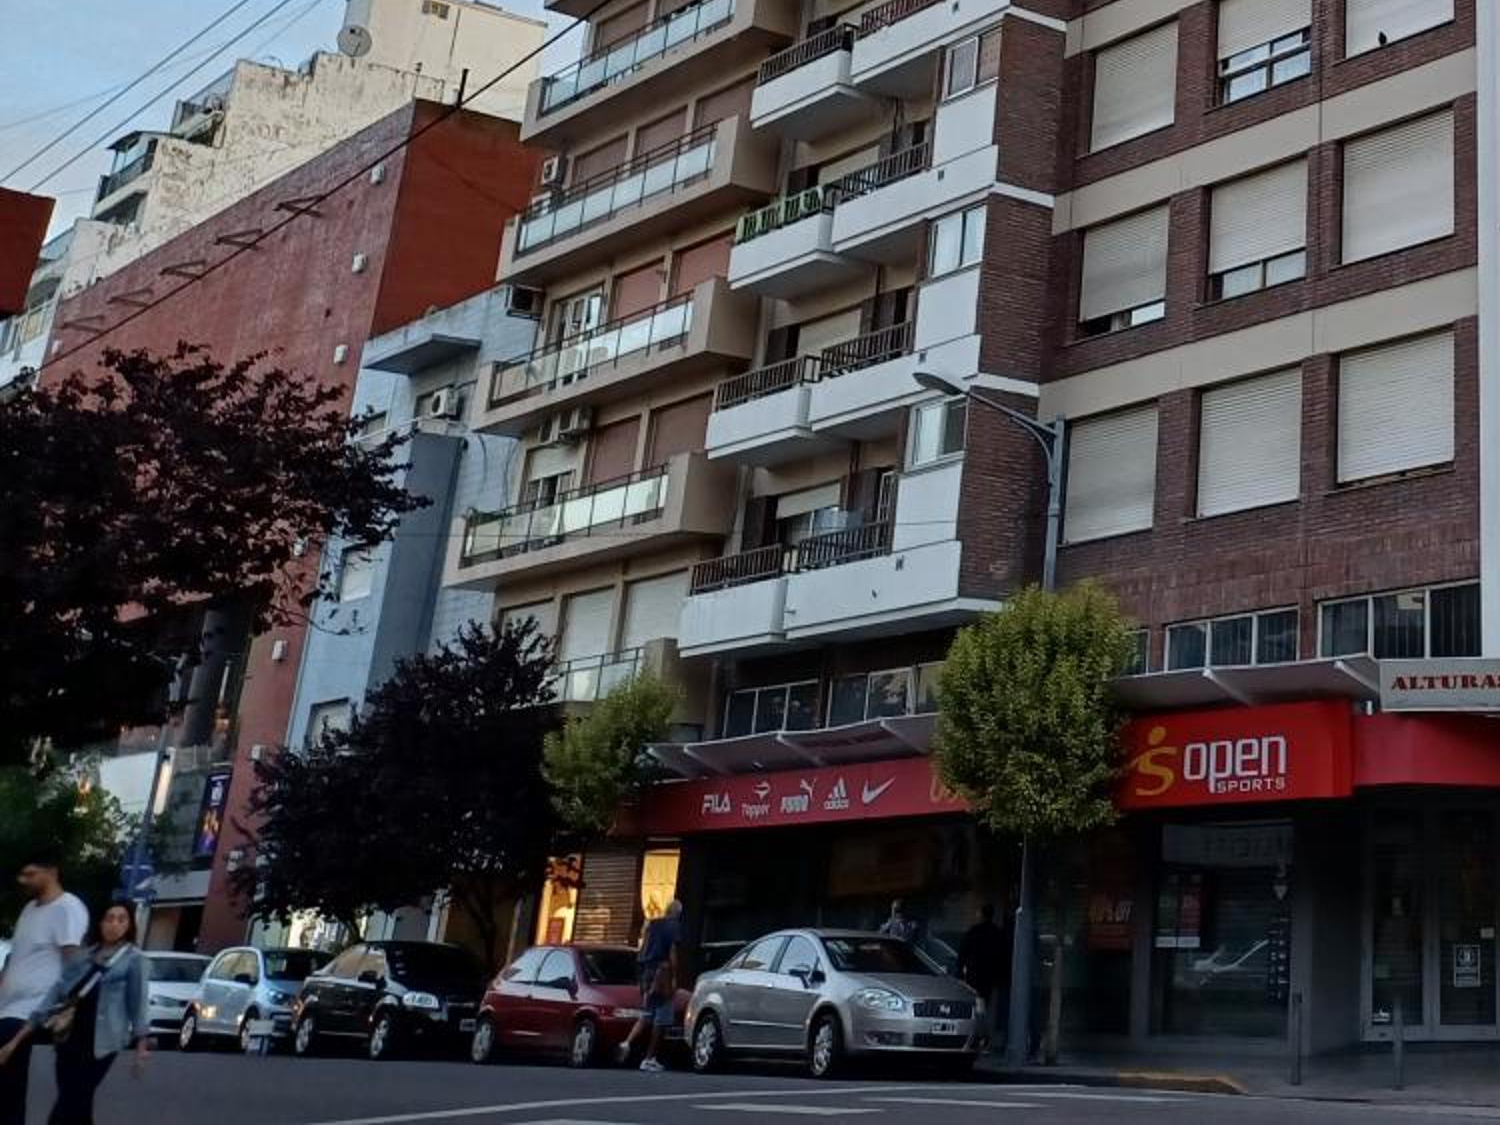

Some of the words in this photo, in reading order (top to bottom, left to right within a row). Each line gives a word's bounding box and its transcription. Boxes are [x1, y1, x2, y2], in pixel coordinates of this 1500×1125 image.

[1183, 735, 1286, 794] open
[1217, 777, 1286, 794] SPORTS
[702, 792, 732, 815] FILA
